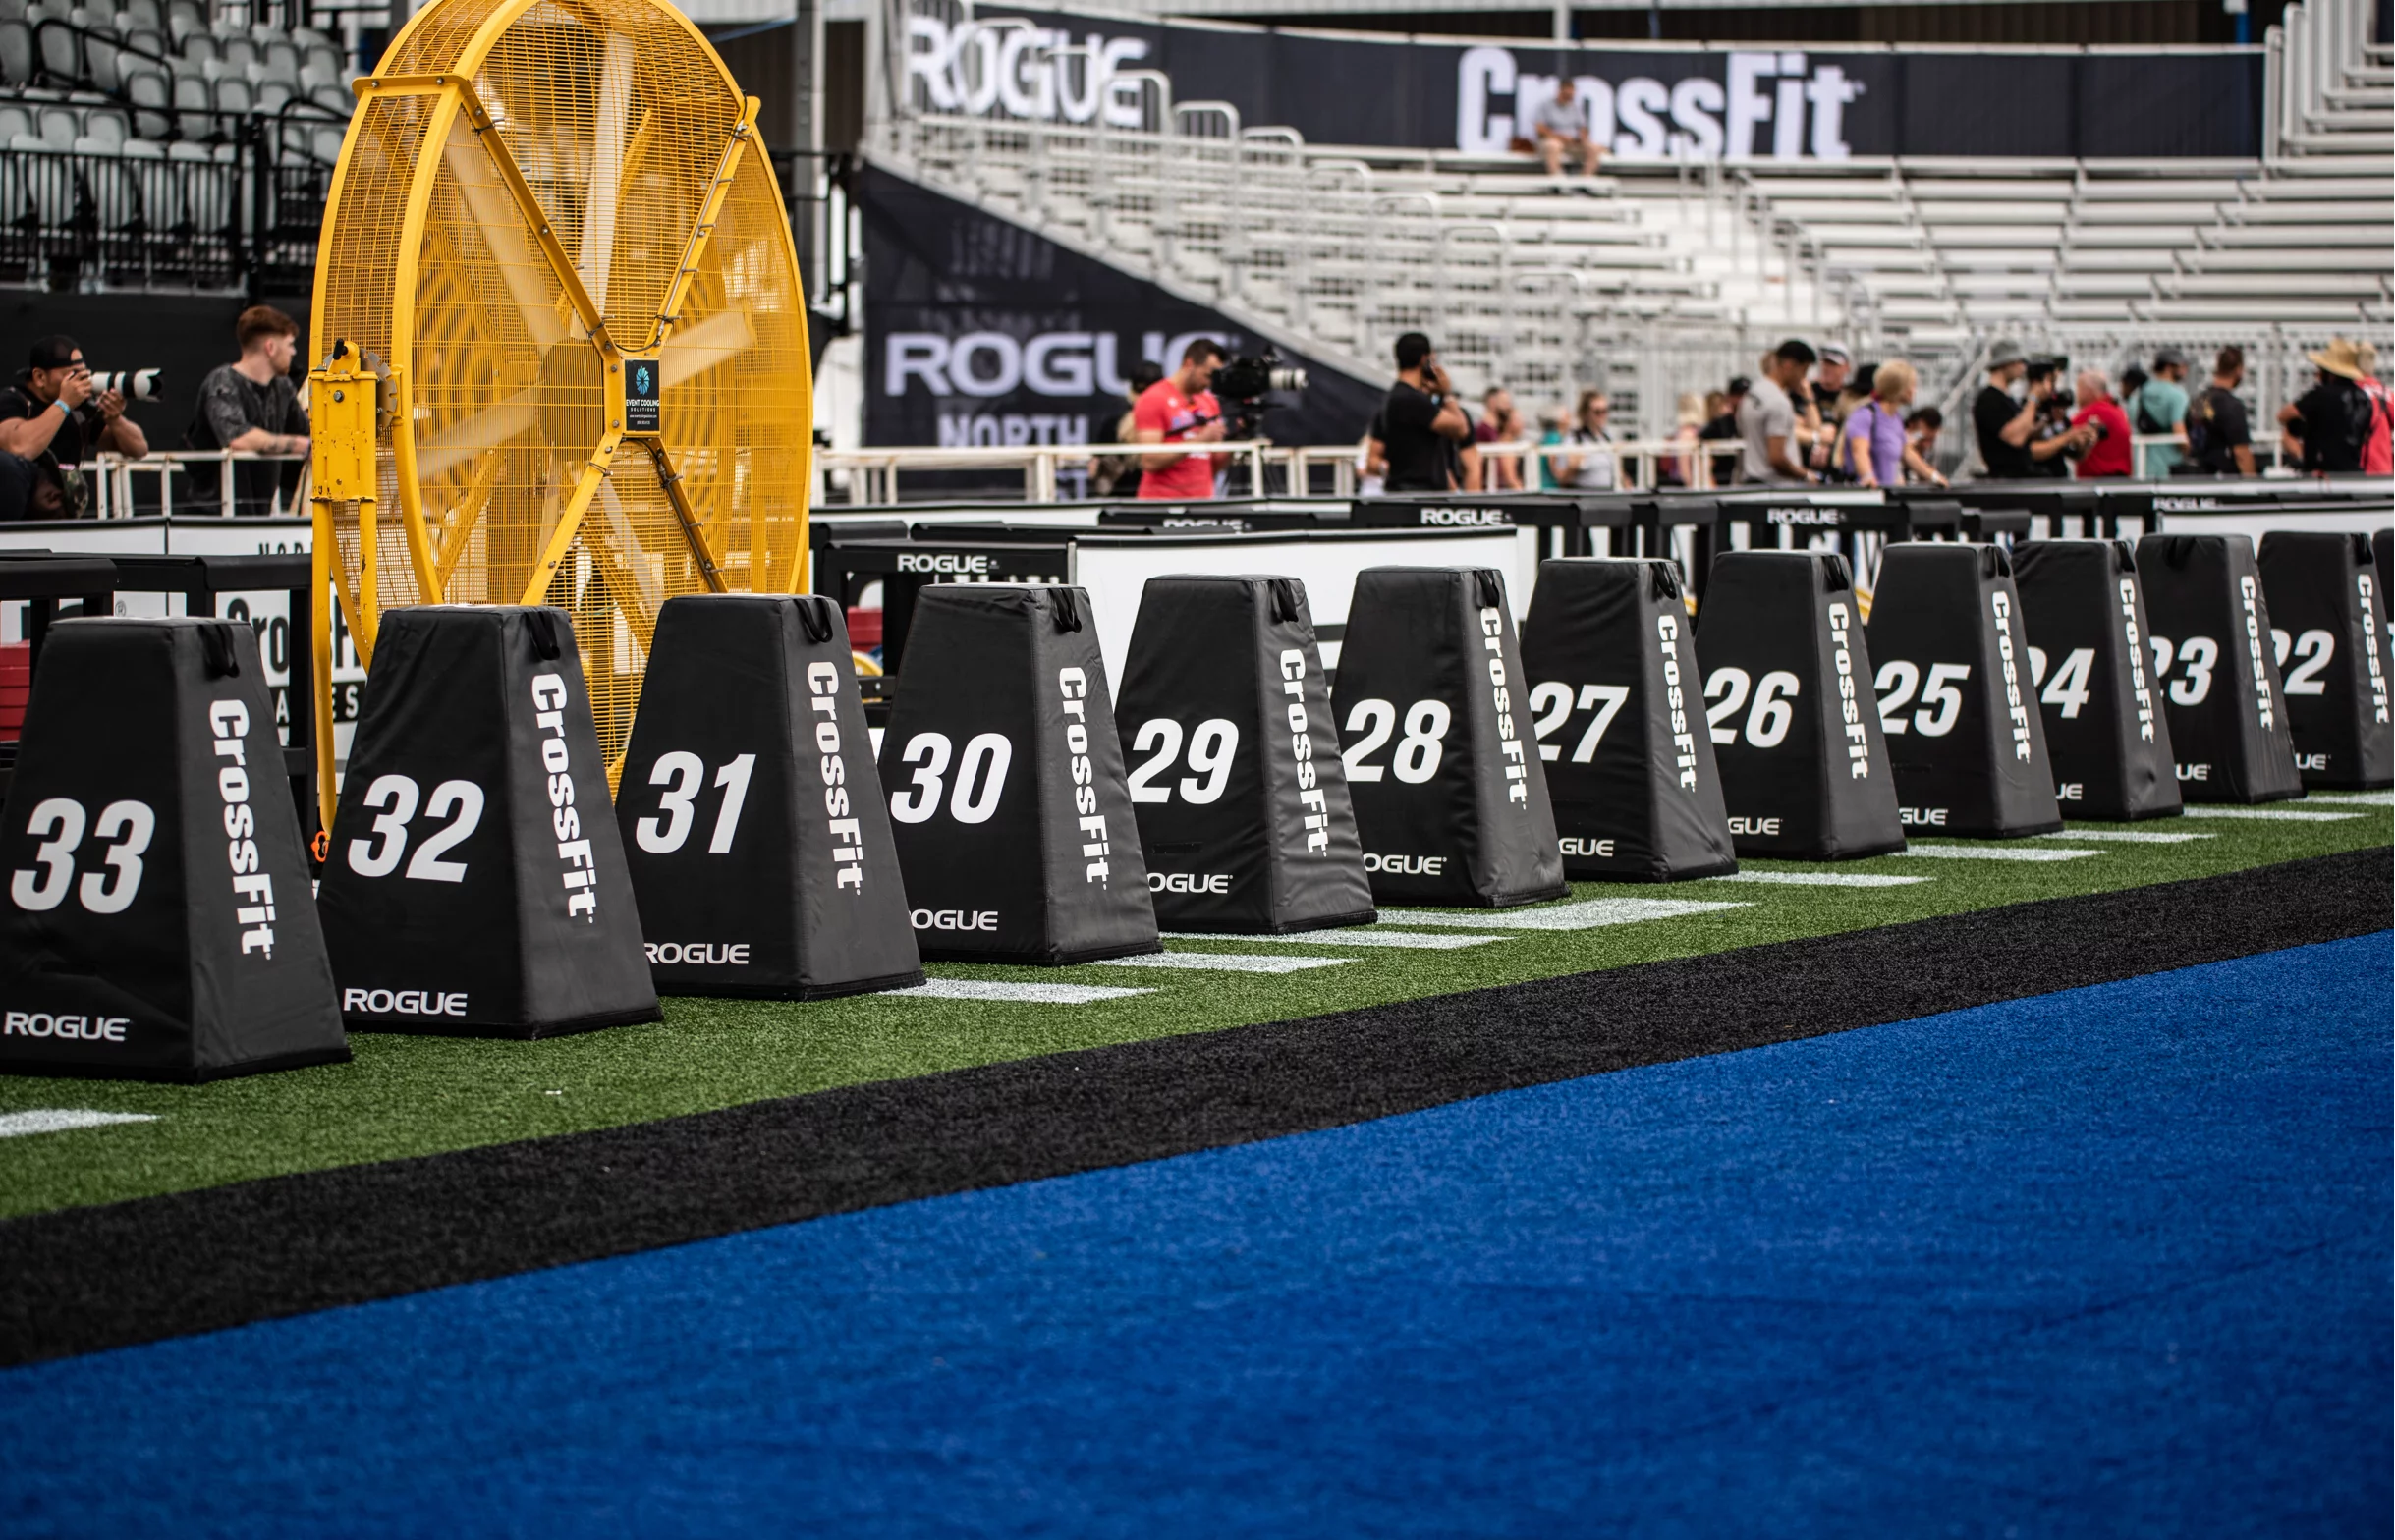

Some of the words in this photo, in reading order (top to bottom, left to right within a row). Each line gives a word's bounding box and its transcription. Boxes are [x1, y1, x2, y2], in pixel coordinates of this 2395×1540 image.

[906, 15, 1148, 127] ROGUE
[1457, 46, 1857, 159] CrossFit
[898, 554, 987, 573] ROGUE
[1420, 508, 1503, 525] ROGUE
[1767, 508, 1838, 525] ROGUE
[1828, 602, 1868, 780] CrossFit
[1992, 591, 2033, 763] CrossFit
[2119, 579, 2156, 743] CrossFit
[2241, 576, 2274, 732] CrossFit
[2359, 574, 2389, 724] CrossFit
[1341, 698, 1451, 784] 28
[1480, 607, 1528, 803] CrossFit
[1529, 682, 1629, 763] 27
[1657, 615, 1697, 790] CrossFit
[1704, 668, 1800, 748] 26
[1874, 660, 1970, 737] 25
[531, 673, 597, 917] CrossFit
[808, 660, 863, 889] CrossFit
[891, 732, 1012, 824] 30
[1059, 667, 1110, 883] CrossFit
[1127, 718, 1239, 804] 29
[1280, 648, 1328, 852] CrossFit
[209, 698, 276, 955] CrossFit
[348, 773, 484, 883] 32
[637, 750, 755, 853] 31
[1558, 837, 1614, 857] GUE
[1727, 817, 1780, 835] GUE
[13, 798, 154, 913] 33
[1147, 872, 1228, 894] OGUE
[1363, 852, 1442, 875] OGUE
[643, 942, 750, 964] ROGUE
[909, 908, 998, 931] OGUE
[5, 1011, 130, 1041] ROGUE
[344, 988, 468, 1016] ROGUE
